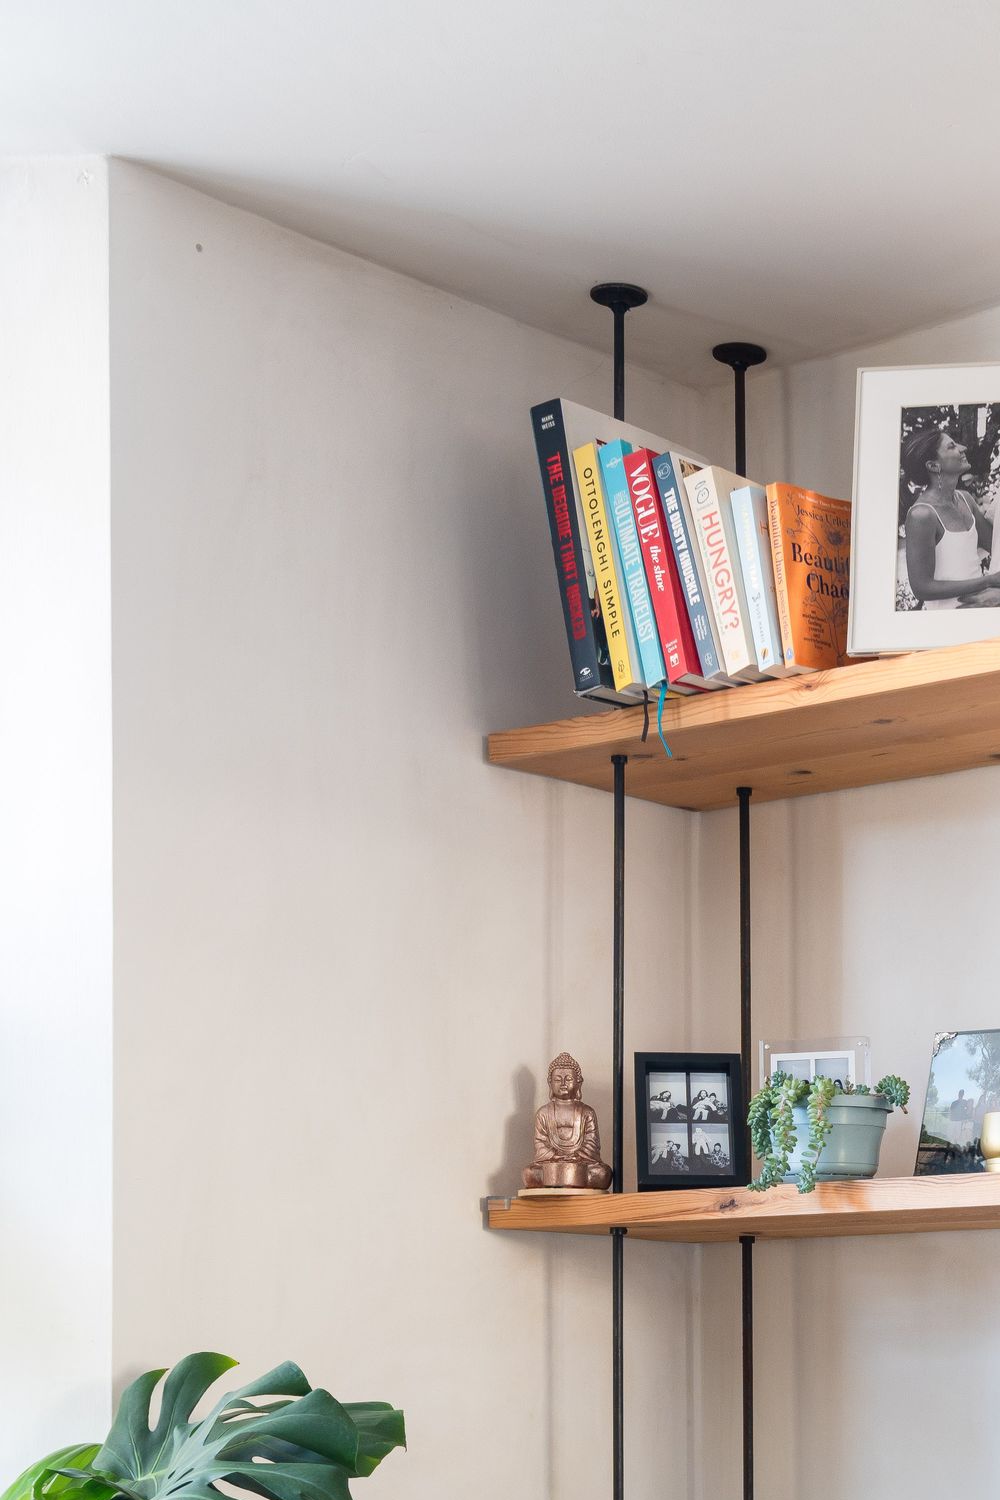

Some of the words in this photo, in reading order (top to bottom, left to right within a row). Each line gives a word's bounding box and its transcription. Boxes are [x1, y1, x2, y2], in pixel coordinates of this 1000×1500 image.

[546, 451, 564, 485] THE
[558, 540, 579, 582] THAT
[630, 462, 660, 543] VOGUE
[664, 487, 678, 513] THE
[770, 499, 781, 549] Beautiful
[796, 505, 824, 521] Jessica
[584, 467, 608, 572] OTTOLENGHI
[603, 580, 620, 638] SIMPLE
[614, 500, 641, 570] ULTIMATE
[649, 546, 661, 563] the
[670, 512, 687, 551] DUSTY
[653, 566, 666, 592] shoe
[678, 549, 701, 606] KNUCKLE
[702, 511, 740, 630] HUNGRY?
[775, 551, 784, 586] Chaos
[627, 566, 655, 643] TRAVELIST
